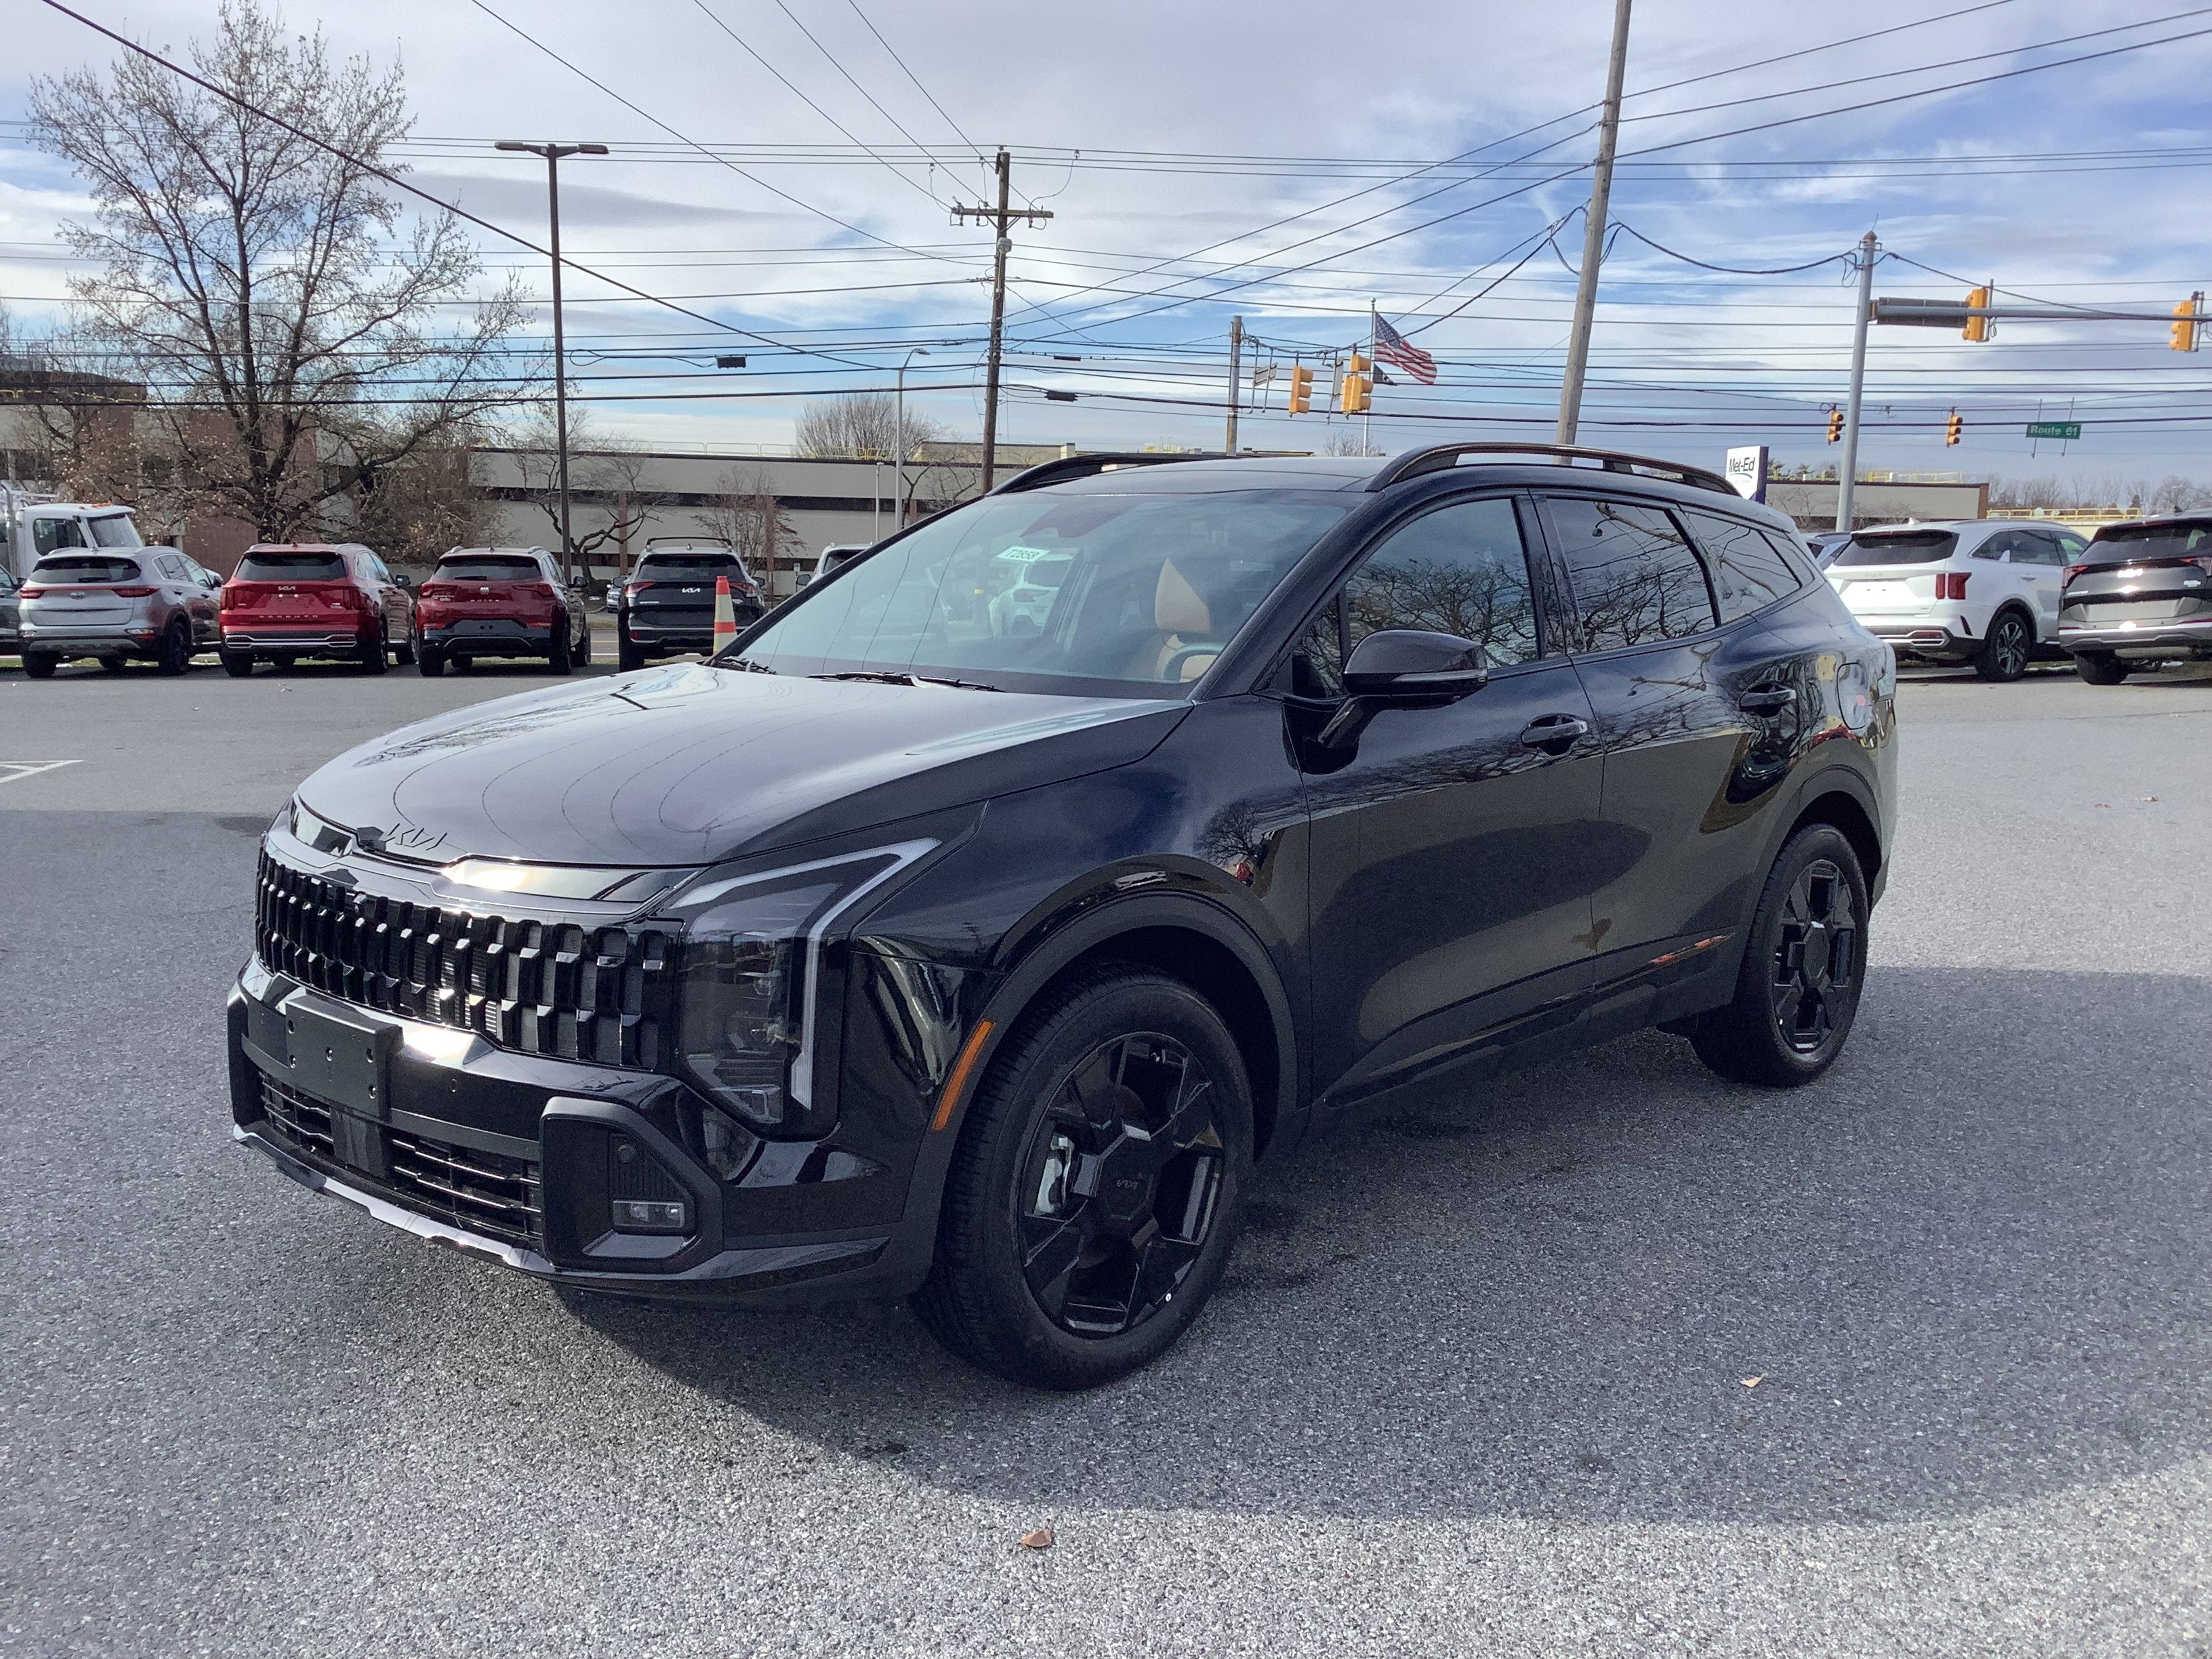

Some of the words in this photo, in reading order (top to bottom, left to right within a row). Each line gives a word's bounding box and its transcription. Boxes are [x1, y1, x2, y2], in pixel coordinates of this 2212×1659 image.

[2030, 425, 2062, 435] Route
[1729, 457, 1755, 472] Met-Ed
[384, 823, 447, 851] KIA
